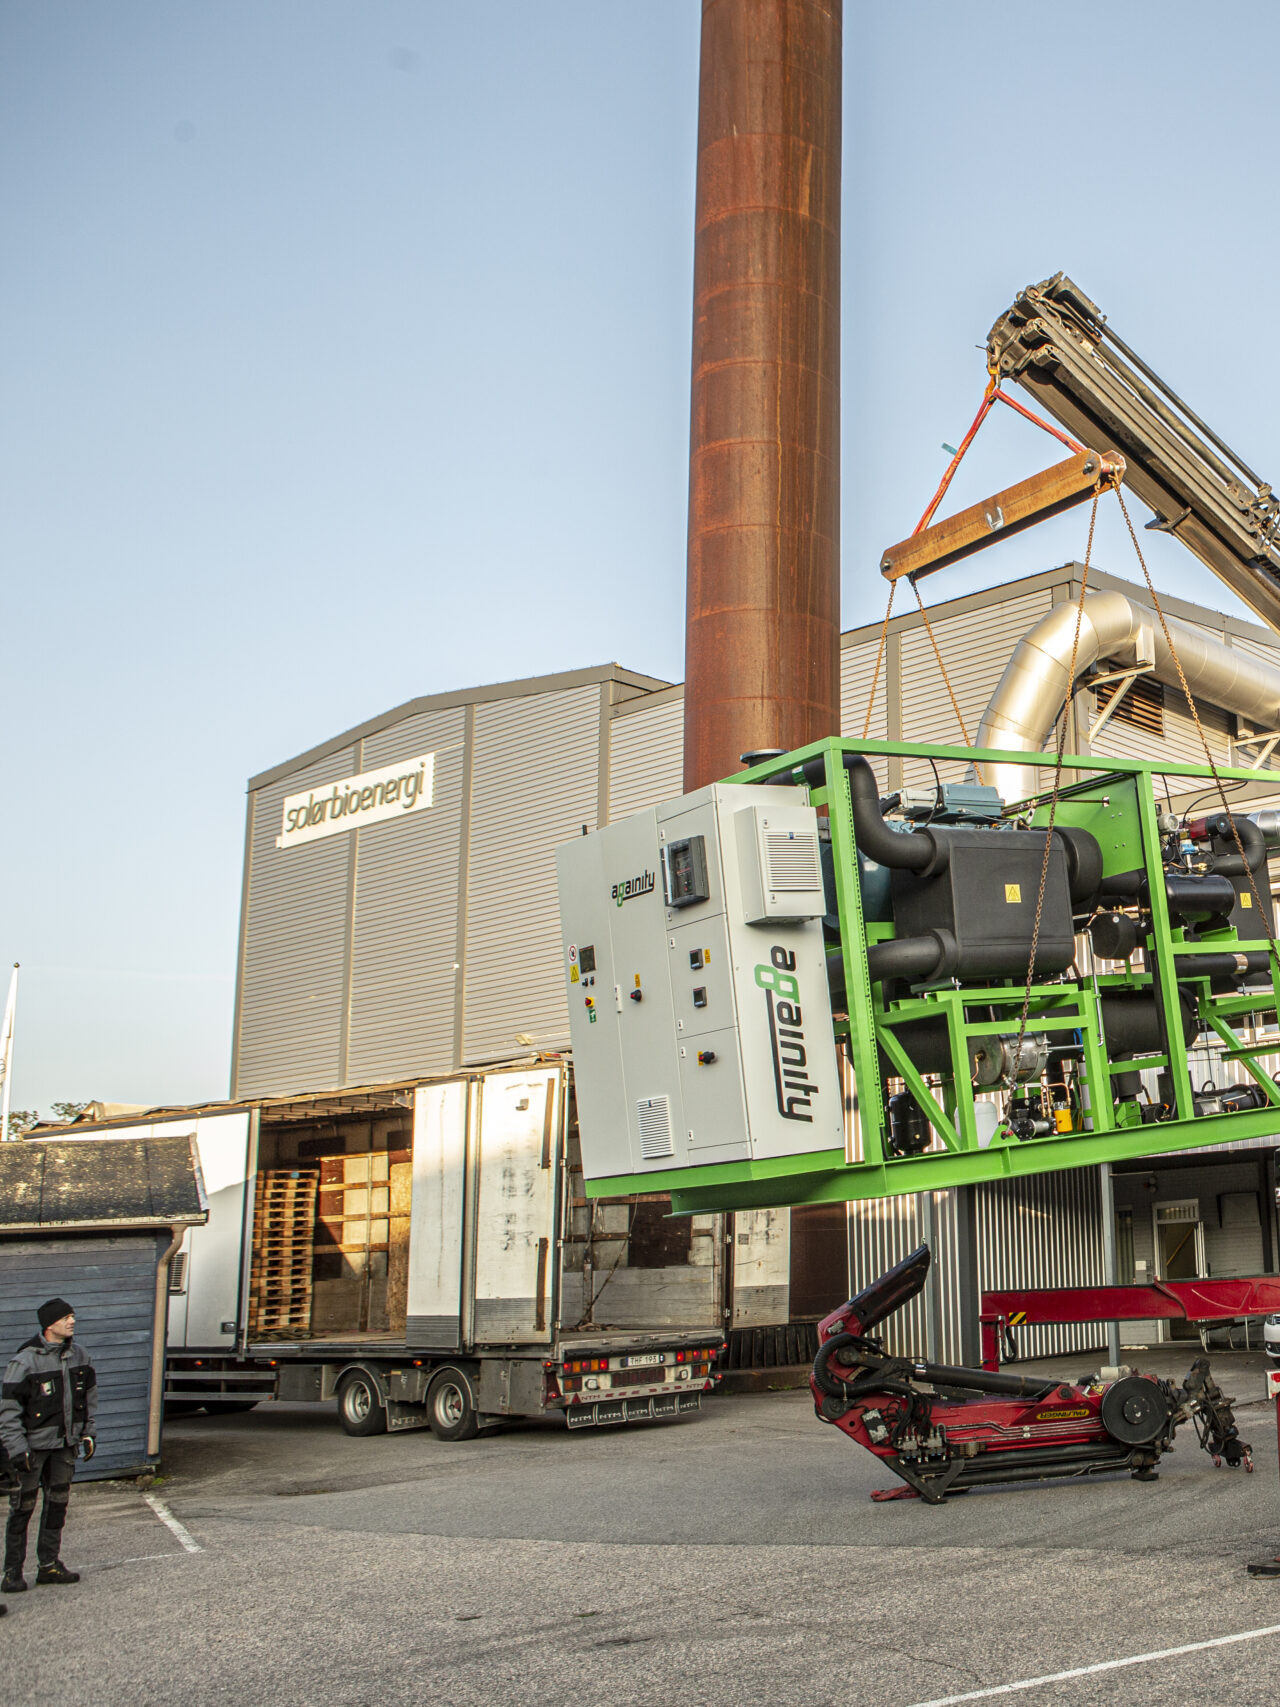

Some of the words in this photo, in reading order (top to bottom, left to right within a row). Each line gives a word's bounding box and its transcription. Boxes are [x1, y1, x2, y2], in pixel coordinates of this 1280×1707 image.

[285, 762, 426, 833] solørbioenergi
[611, 869, 655, 907] againity
[754, 945, 819, 1123] againity
[570, 1415, 592, 1423] NTM
[600, 1412, 622, 1420] NTM
